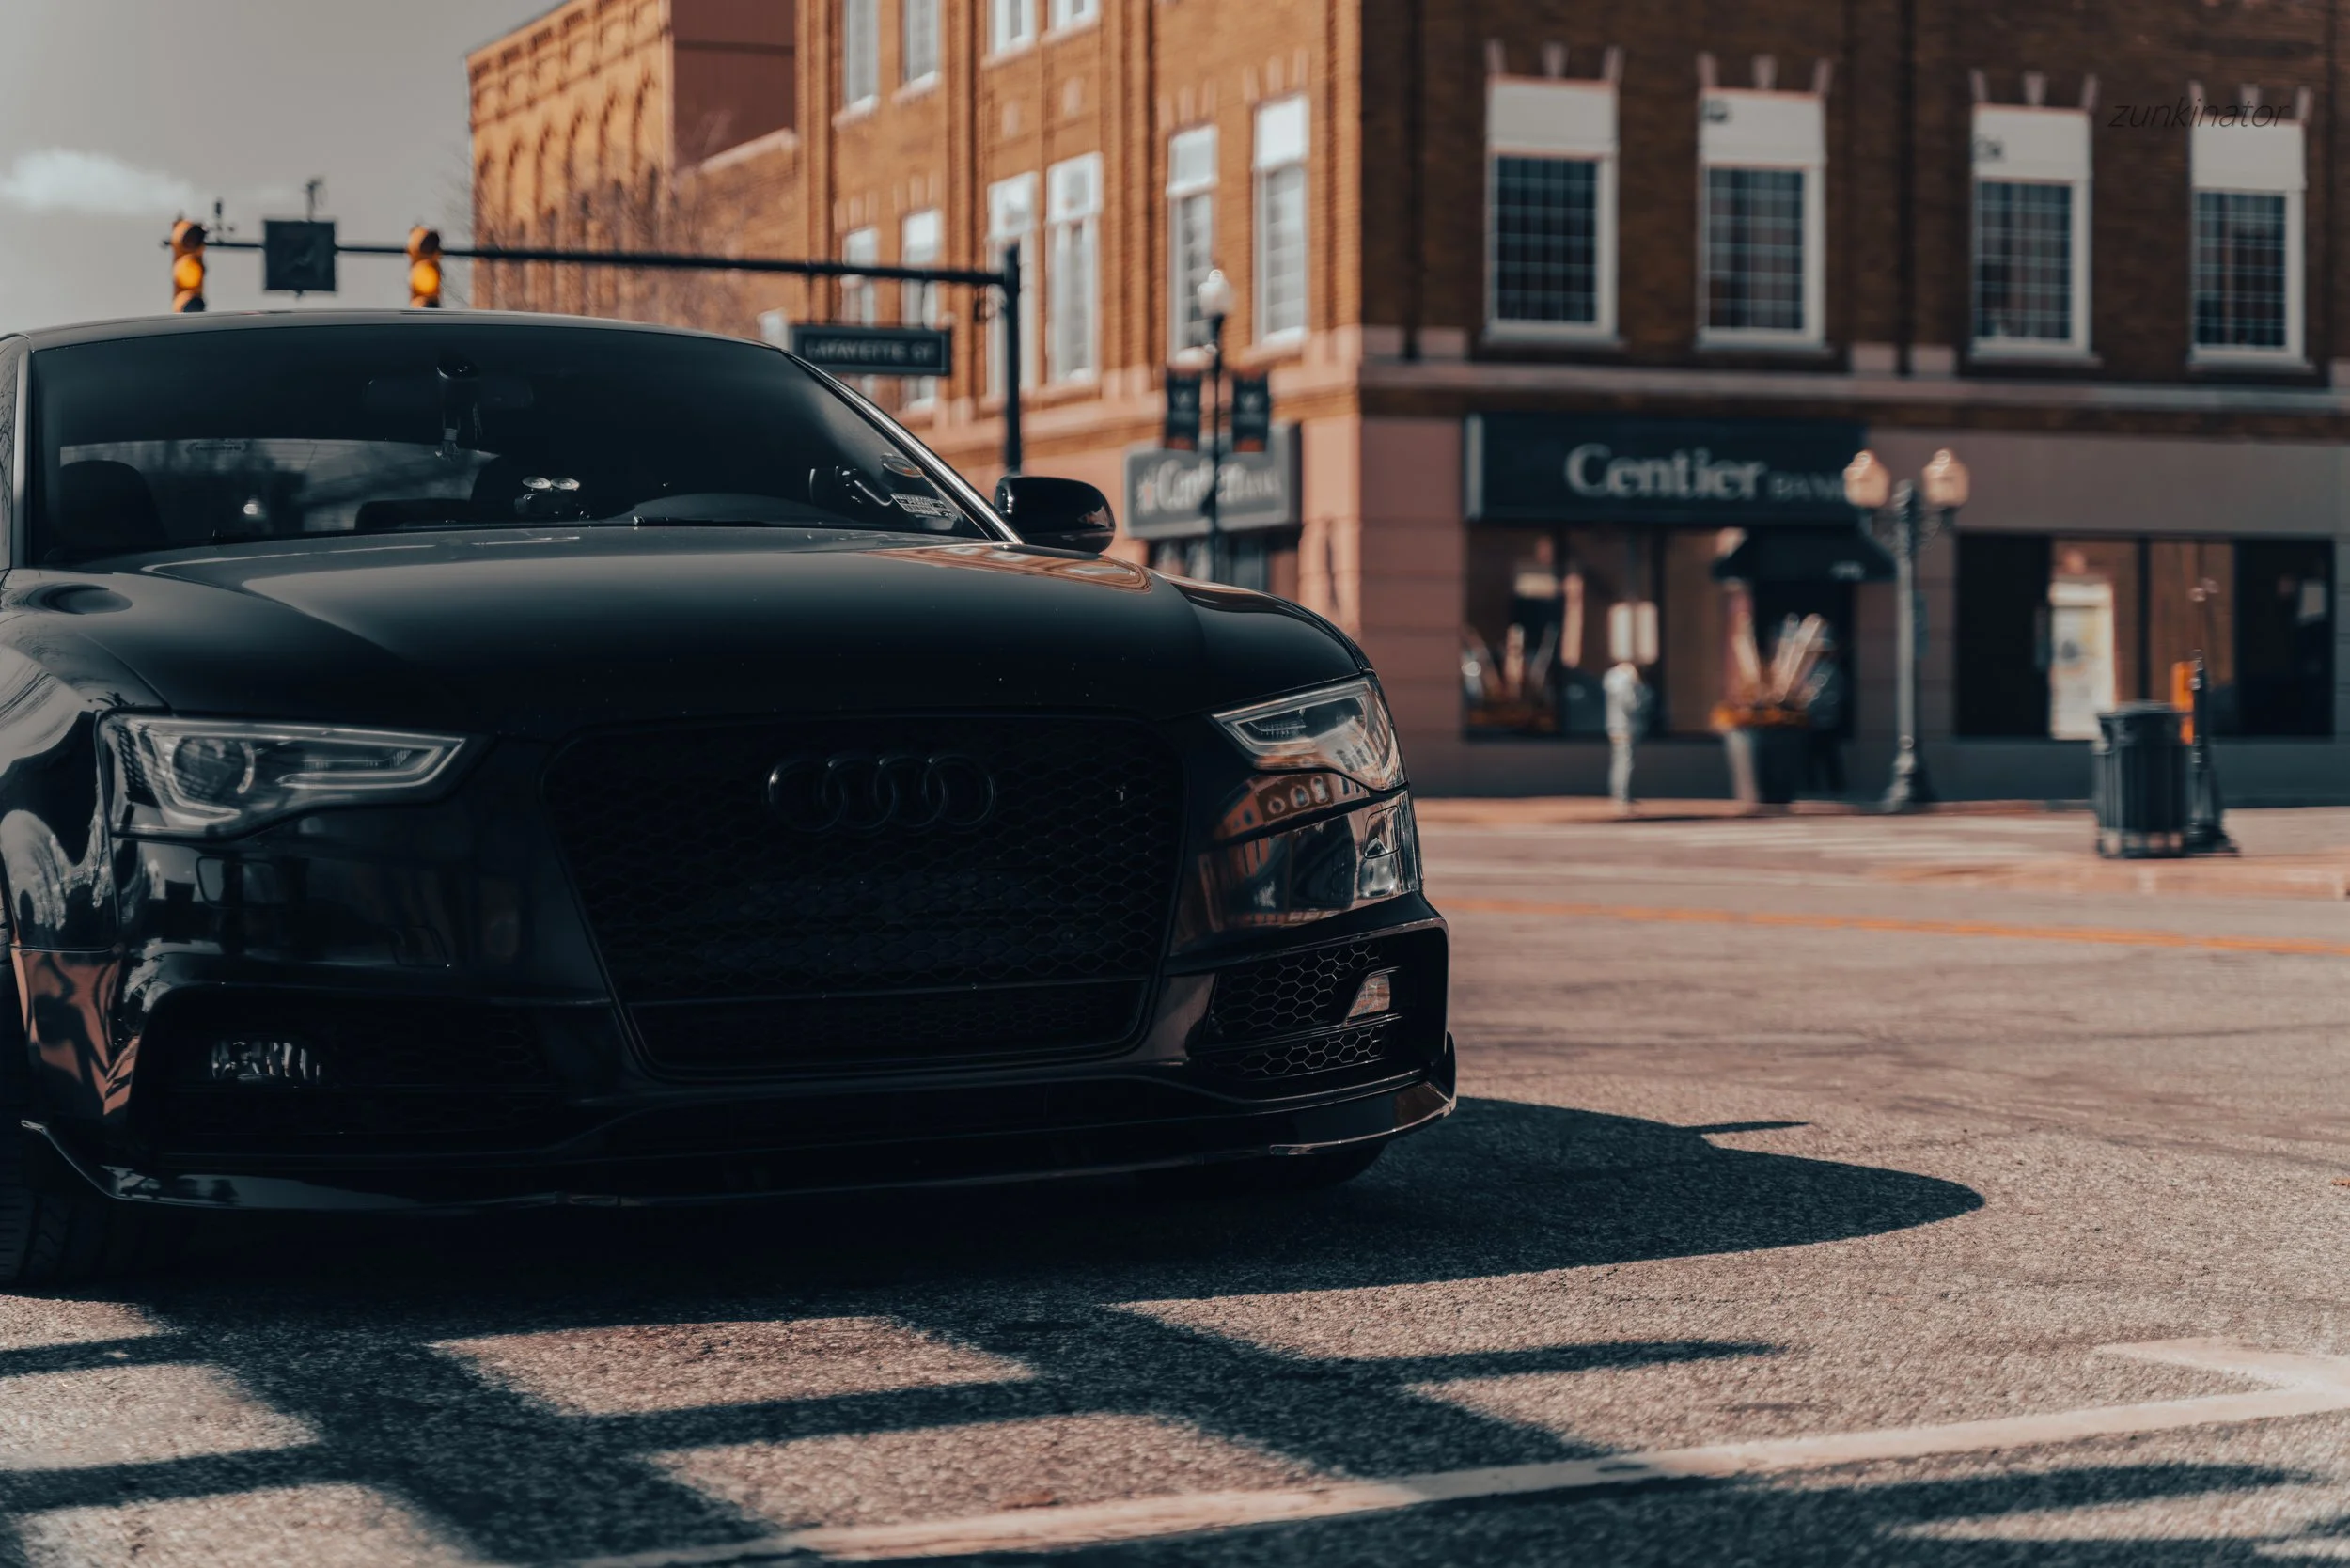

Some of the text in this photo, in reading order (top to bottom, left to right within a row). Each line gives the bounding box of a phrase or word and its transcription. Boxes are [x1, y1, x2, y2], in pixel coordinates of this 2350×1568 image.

[806, 339, 908, 363] LAFAYETTE
[1564, 442, 1844, 501] Centier BAN
